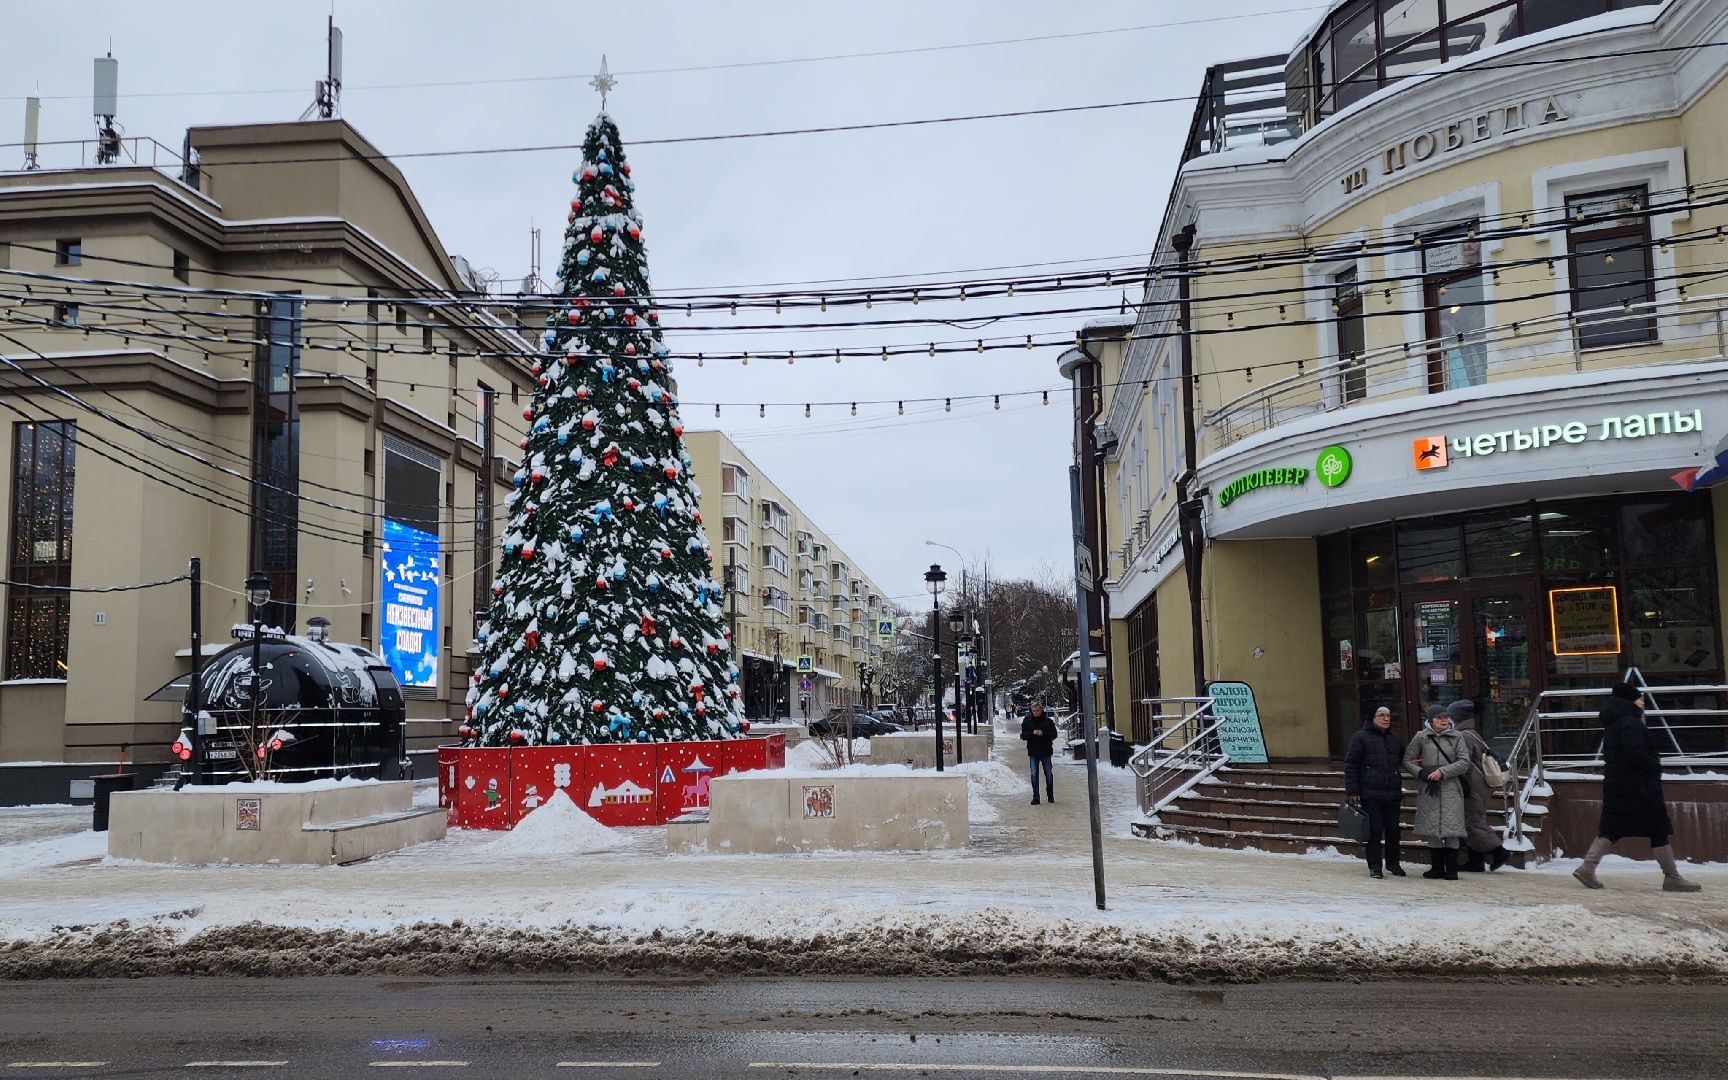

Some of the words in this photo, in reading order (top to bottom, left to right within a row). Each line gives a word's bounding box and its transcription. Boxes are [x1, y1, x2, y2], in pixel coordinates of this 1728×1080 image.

[1341, 168, 1368, 194] ТЦ
[1381, 96, 1568, 175] ПОБЕДА
[1452, 420, 1588, 458] четыре
[1599, 409, 1703, 441] лапы
[1218, 468, 1309, 508] КУУЛКЛЕВЕР
[386, 602, 432, 631] НЕИЗВЕСТНЫЙ
[396, 629, 423, 654] СОЛДАТ
[1211, 687, 1249, 696] САЛОН
[1216, 697, 1248, 707] ШТОР
